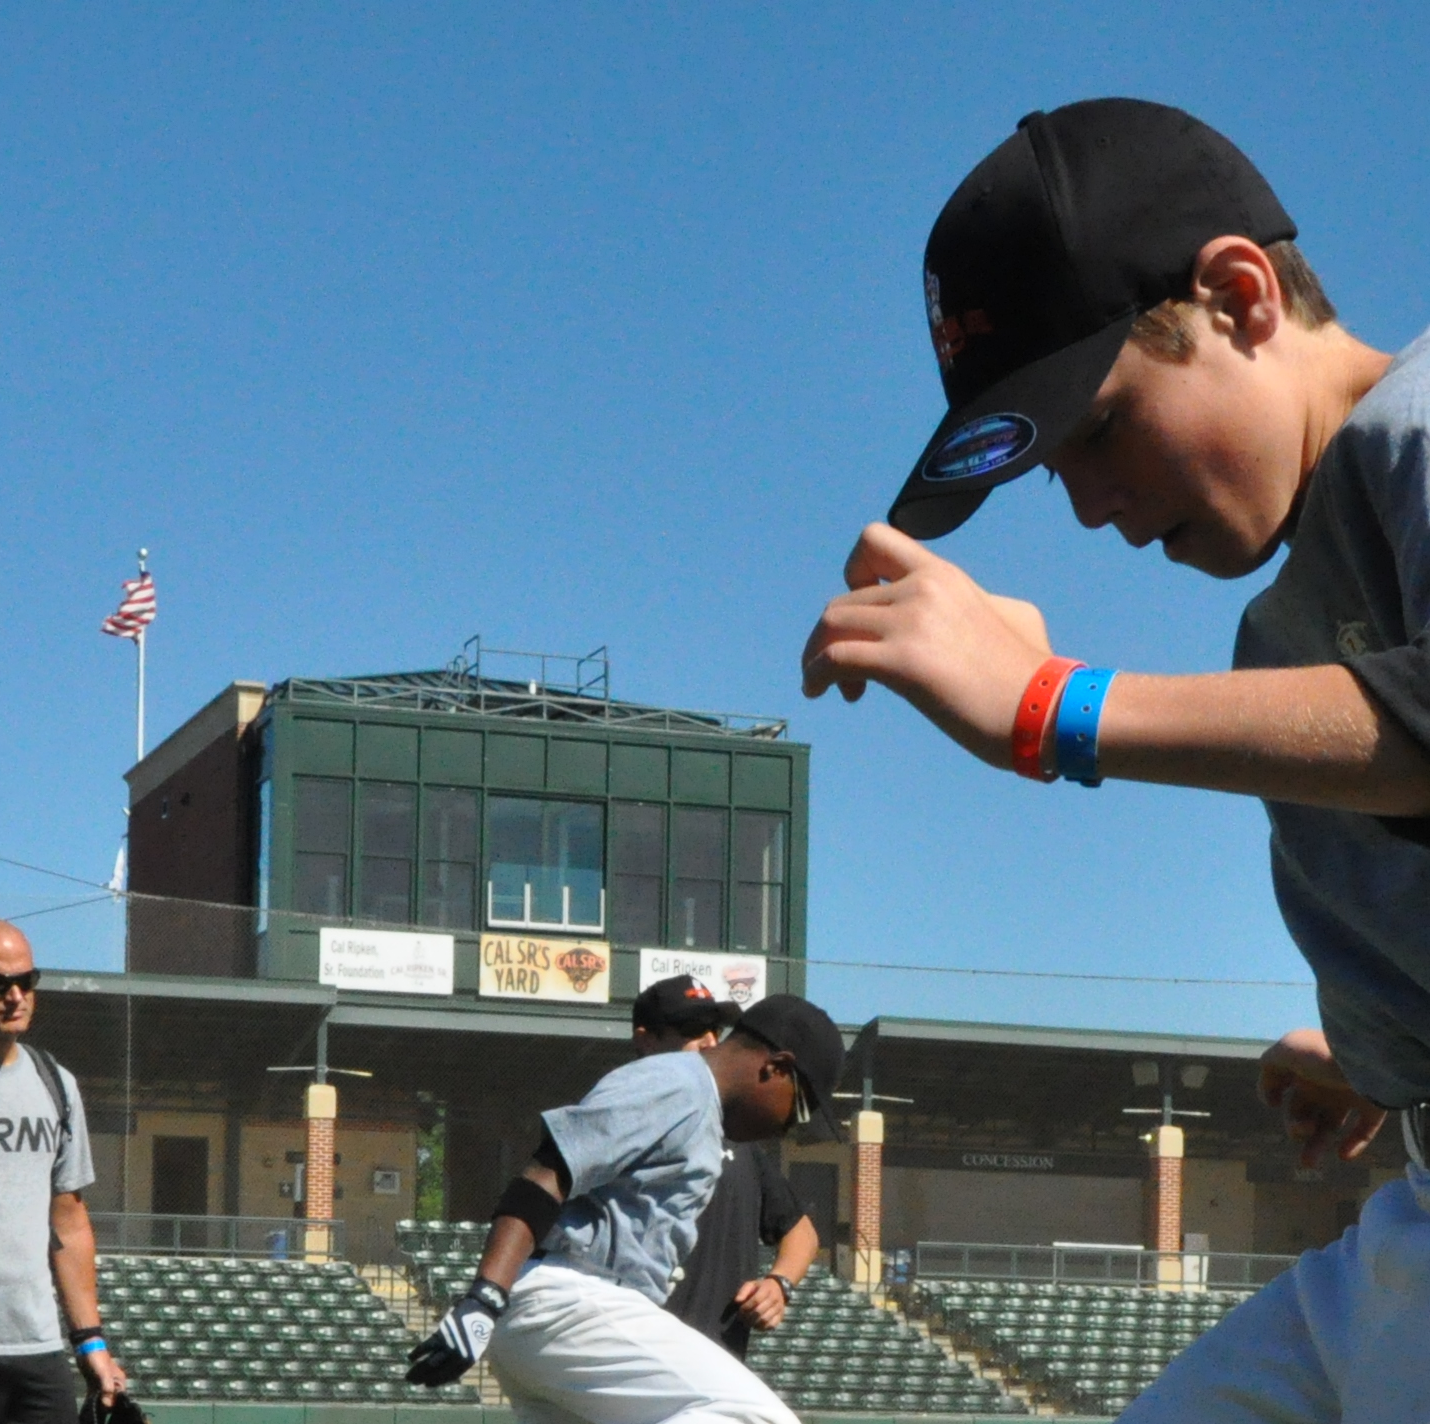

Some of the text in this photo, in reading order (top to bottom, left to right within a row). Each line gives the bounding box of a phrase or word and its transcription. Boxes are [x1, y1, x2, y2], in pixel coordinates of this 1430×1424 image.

[331, 940, 345, 954] Cal
[484, 940, 550, 970] CAL SR'S
[337, 963, 385, 979] Foundation
[652, 957, 712, 976] Cal Ripken
[495, 967, 540, 994] YARD
[962, 1153, 1054, 1169] CONCESSION
